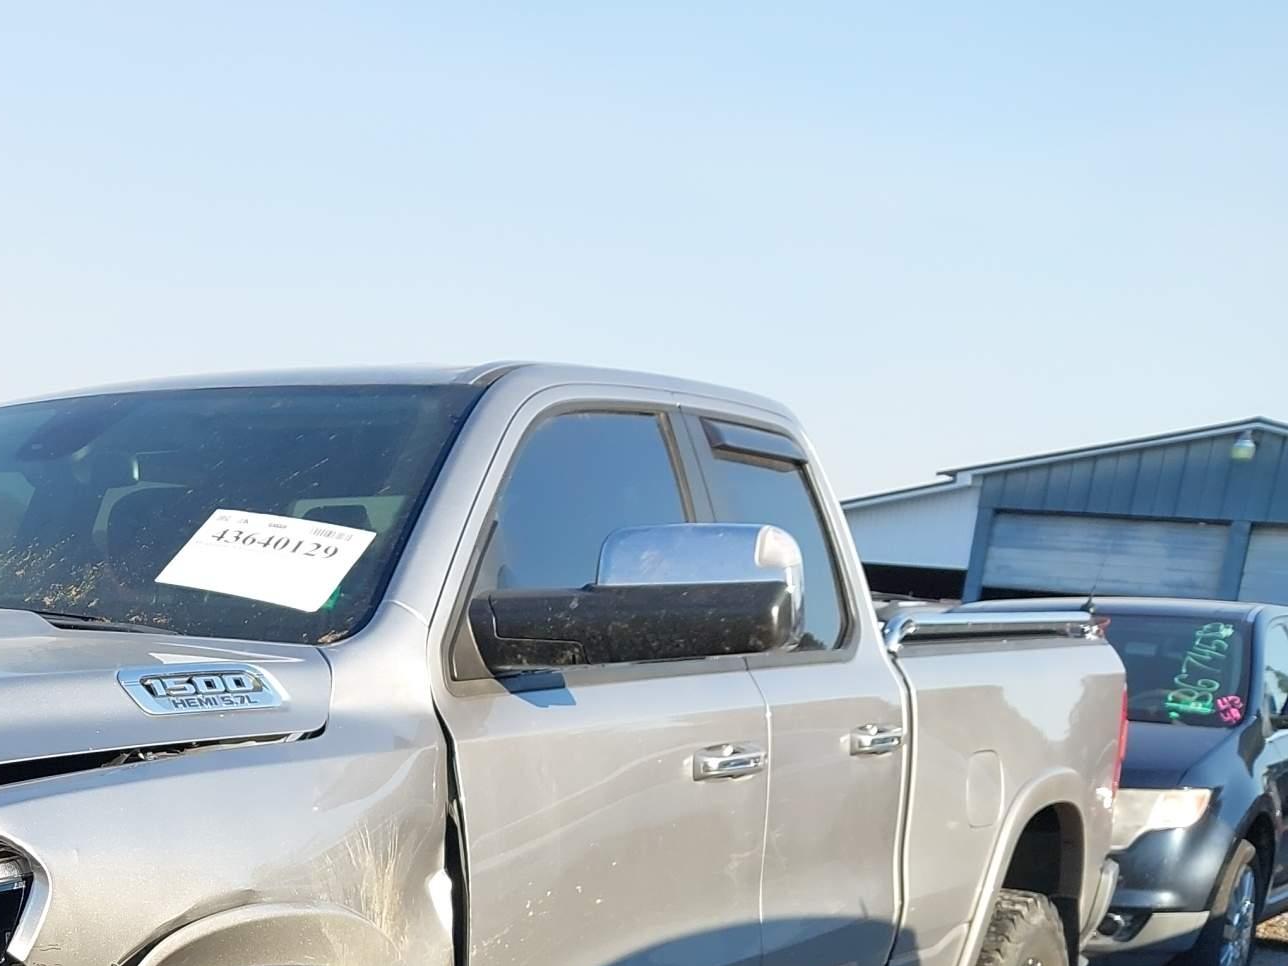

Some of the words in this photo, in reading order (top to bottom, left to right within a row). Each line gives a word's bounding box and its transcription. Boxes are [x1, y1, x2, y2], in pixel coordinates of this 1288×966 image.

[211, 528, 339, 560] 43640129
[144, 673, 255, 697] 1500
[172, 698, 219, 710] HEMI
[220, 695, 258, 706] 5.7L
